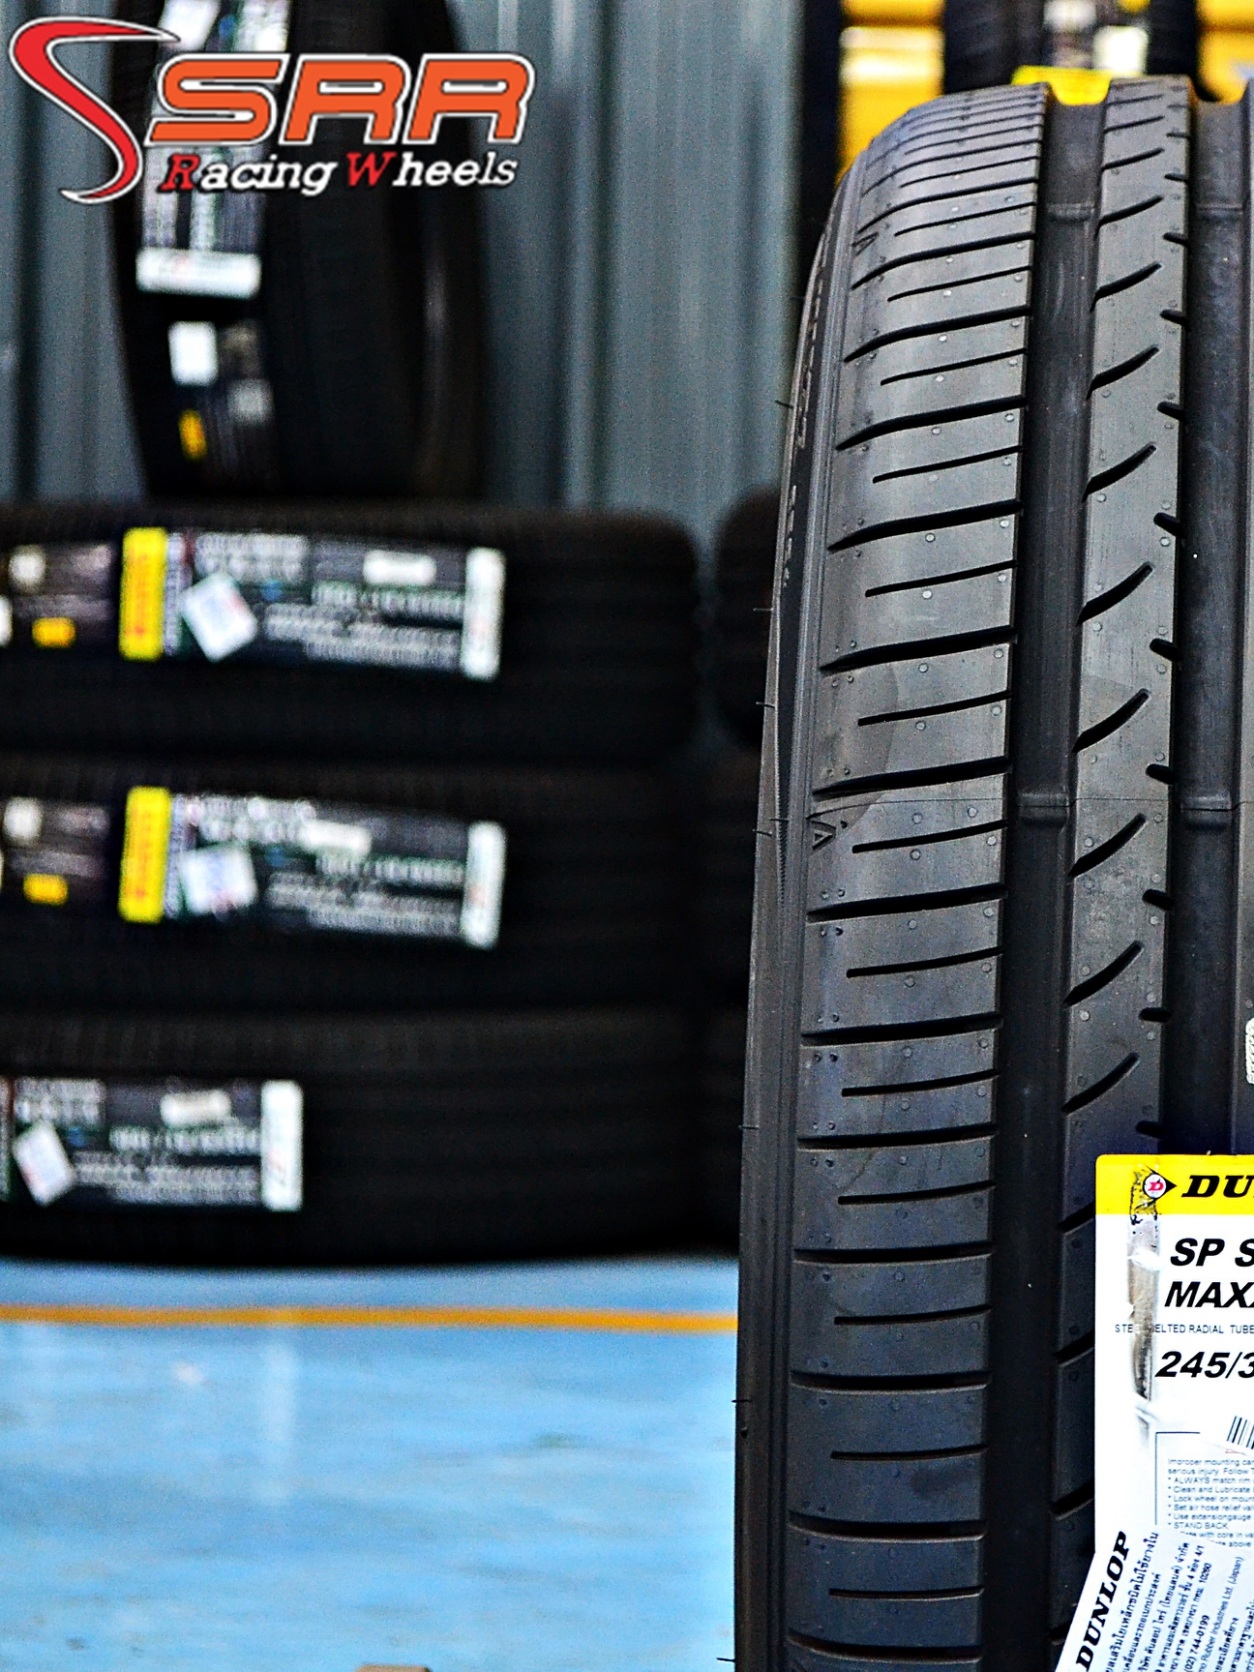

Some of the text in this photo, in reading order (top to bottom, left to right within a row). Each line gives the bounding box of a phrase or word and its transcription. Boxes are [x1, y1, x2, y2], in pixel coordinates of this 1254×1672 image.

[1170, 1238, 1225, 1267] SP
[1189, 1325, 1224, 1334] RADIAL
[1076, 1531, 1130, 1672] DUNLOP
[1189, 1614, 1210, 1655] 744-0199
[1200, 1636, 1215, 1661] Rubber
[1212, 1600, 1228, 1635] Industries
